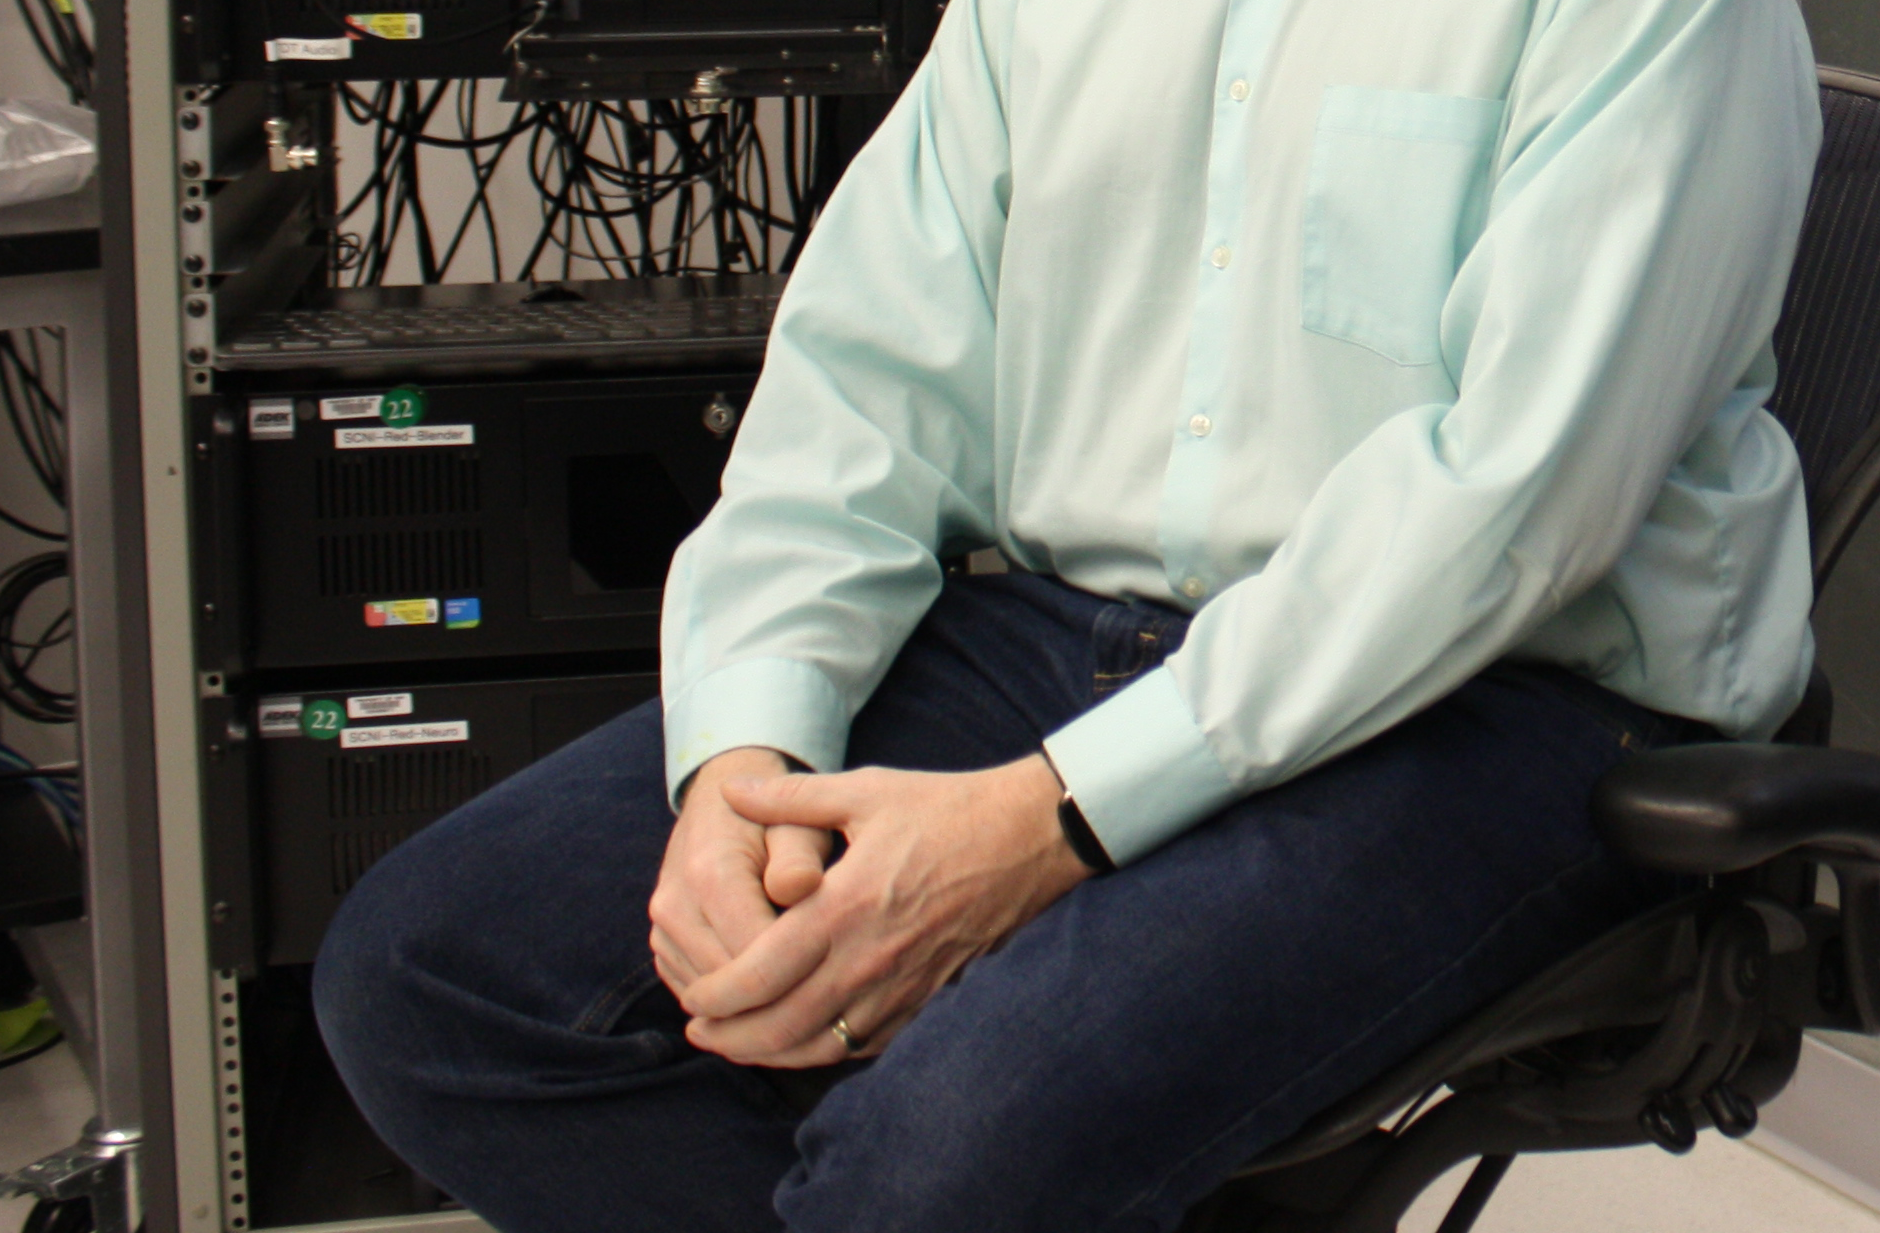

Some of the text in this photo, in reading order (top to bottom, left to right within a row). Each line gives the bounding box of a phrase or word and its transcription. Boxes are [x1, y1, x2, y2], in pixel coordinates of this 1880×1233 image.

[387, 398, 414, 420] 22
[343, 428, 464, 445] SCNI-Red-Blender
[310, 710, 337, 730] 22
[348, 727, 460, 744] SCNI-Red-Neuro
